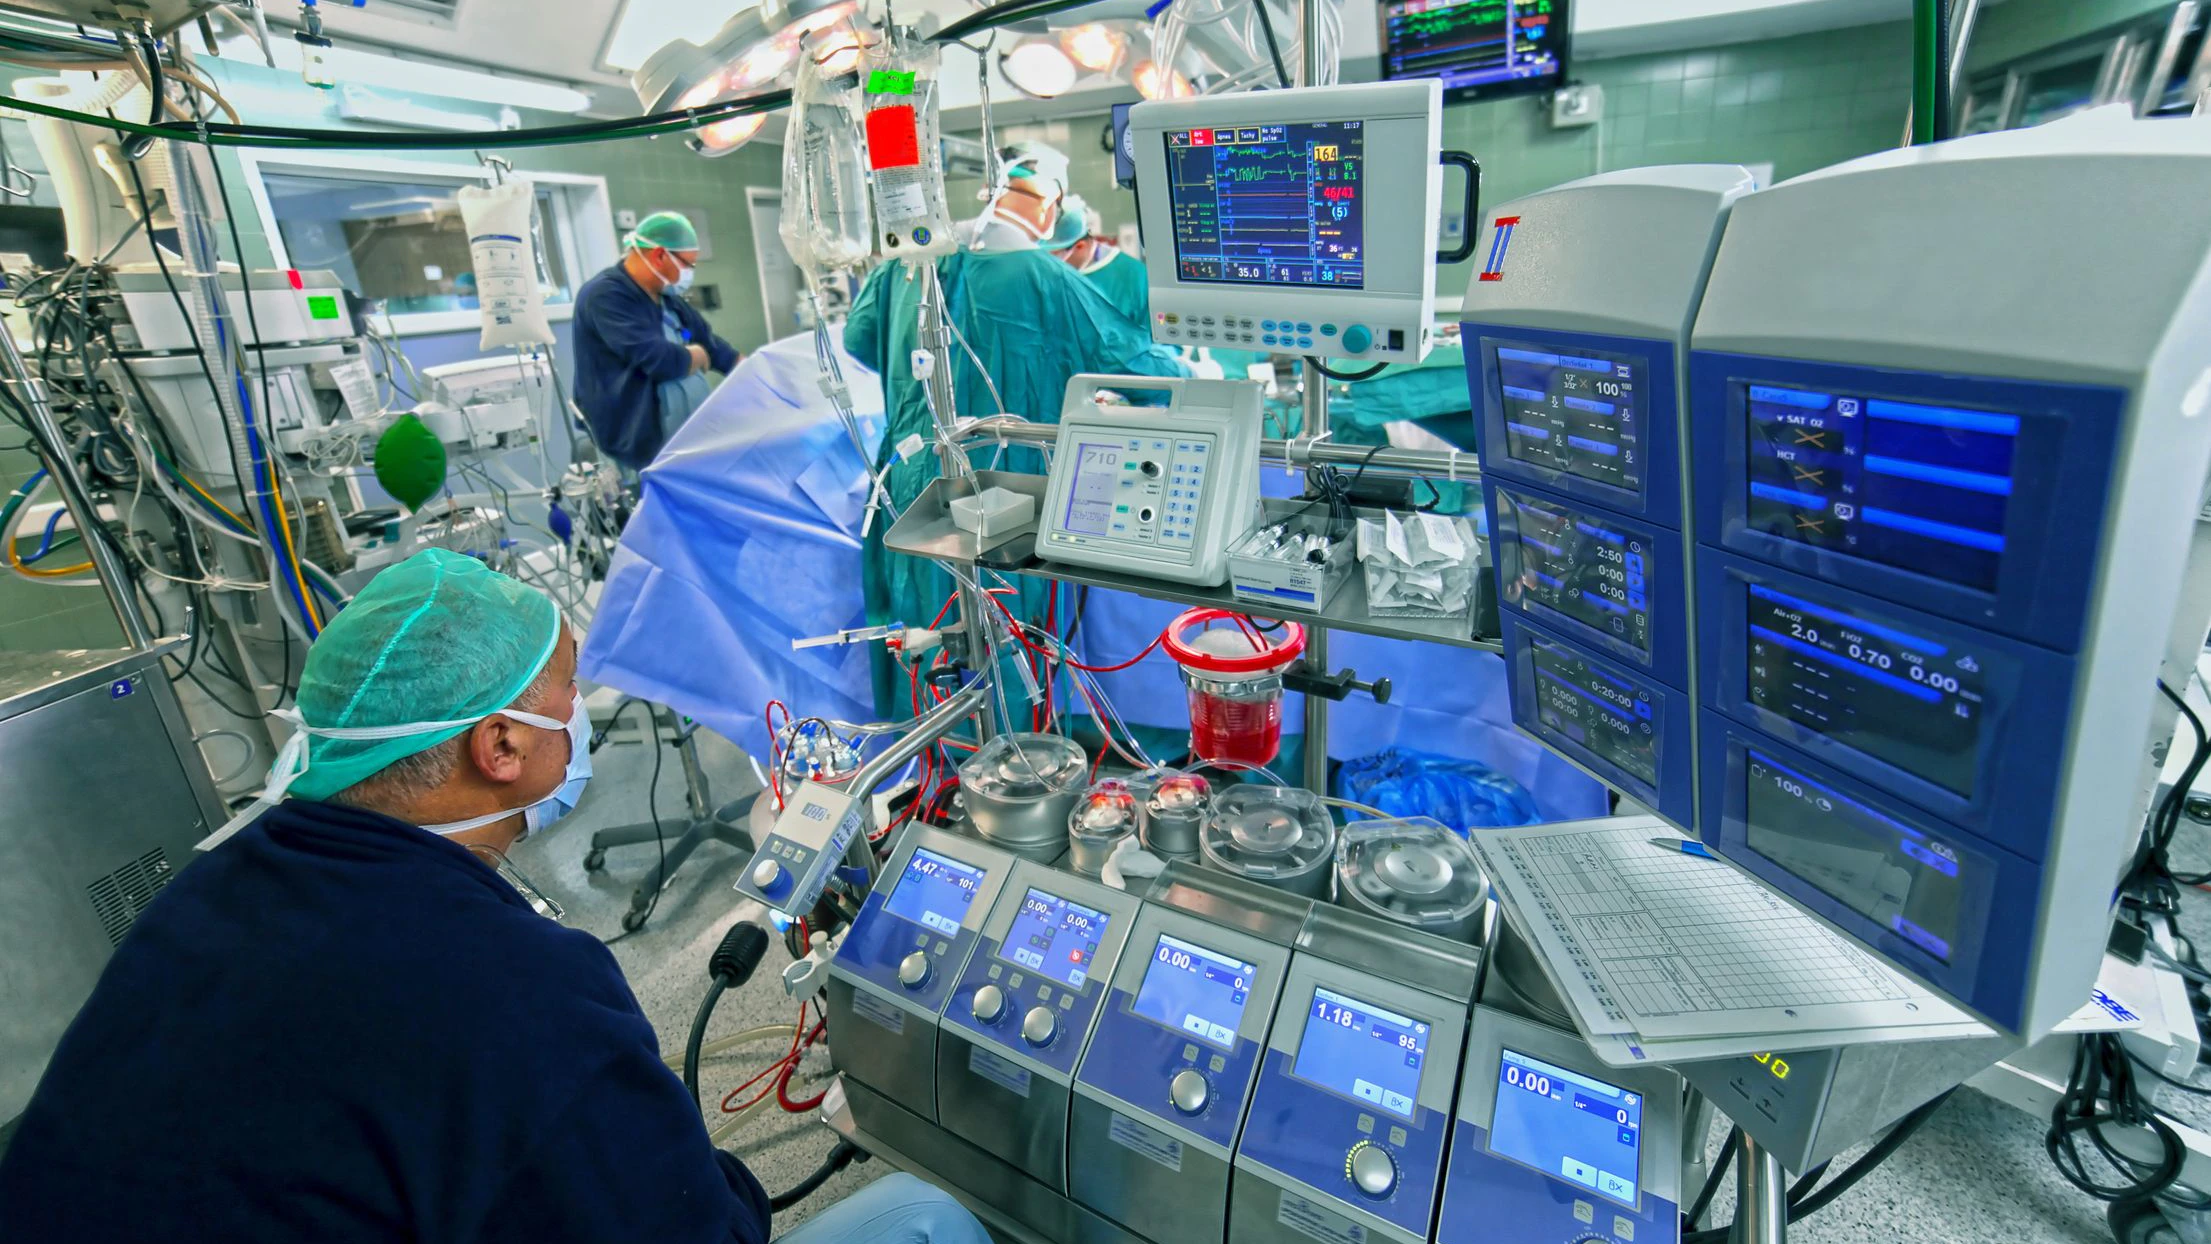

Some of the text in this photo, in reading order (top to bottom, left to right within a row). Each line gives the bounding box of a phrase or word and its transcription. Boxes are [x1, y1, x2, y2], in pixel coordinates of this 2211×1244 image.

[1316, 148, 1337, 160] 164
[1332, 207, 1348, 218] (5)
[1238, 268, 1259, 277] 35.0
[1322, 271, 1333, 281] 38
[1596, 381, 1619, 396] 100
[1786, 414, 1805, 425] SAT
[1086, 452, 1117, 465] 710
[1777, 449, 1796, 461] HCT
[1596, 546, 1622, 564] 2:50
[1598, 564, 1624, 582] 0:00
[1600, 582, 1625, 601] 0:00
[1791, 624, 1818, 643] 2.0
[1848, 644, 1891, 669] 0.70
[1909, 665, 1959, 693] 0.00
[117, 685, 126, 694] 2
[1551, 685, 1578, 706] 0.000
[1591, 681, 1632, 708] 0:20:00
[1552, 698, 1578, 718] 00:00
[1601, 712, 1630, 735] 0.000
[1774, 775, 1803, 798] 100
[912, 859, 937, 875] 4.47
[958, 878, 974, 890] 101
[1027, 899, 1047, 913] 0.00
[1067, 914, 1088, 928] 0.00
[1159, 947, 1190, 969] 0.00
[1234, 977, 1243, 988] 0
[1318, 1003, 1353, 1027] 1.18
[1398, 1034, 1416, 1050] 95
[1507, 1066, 1550, 1095] 0.00
[1616, 1109, 1627, 1124] 0
